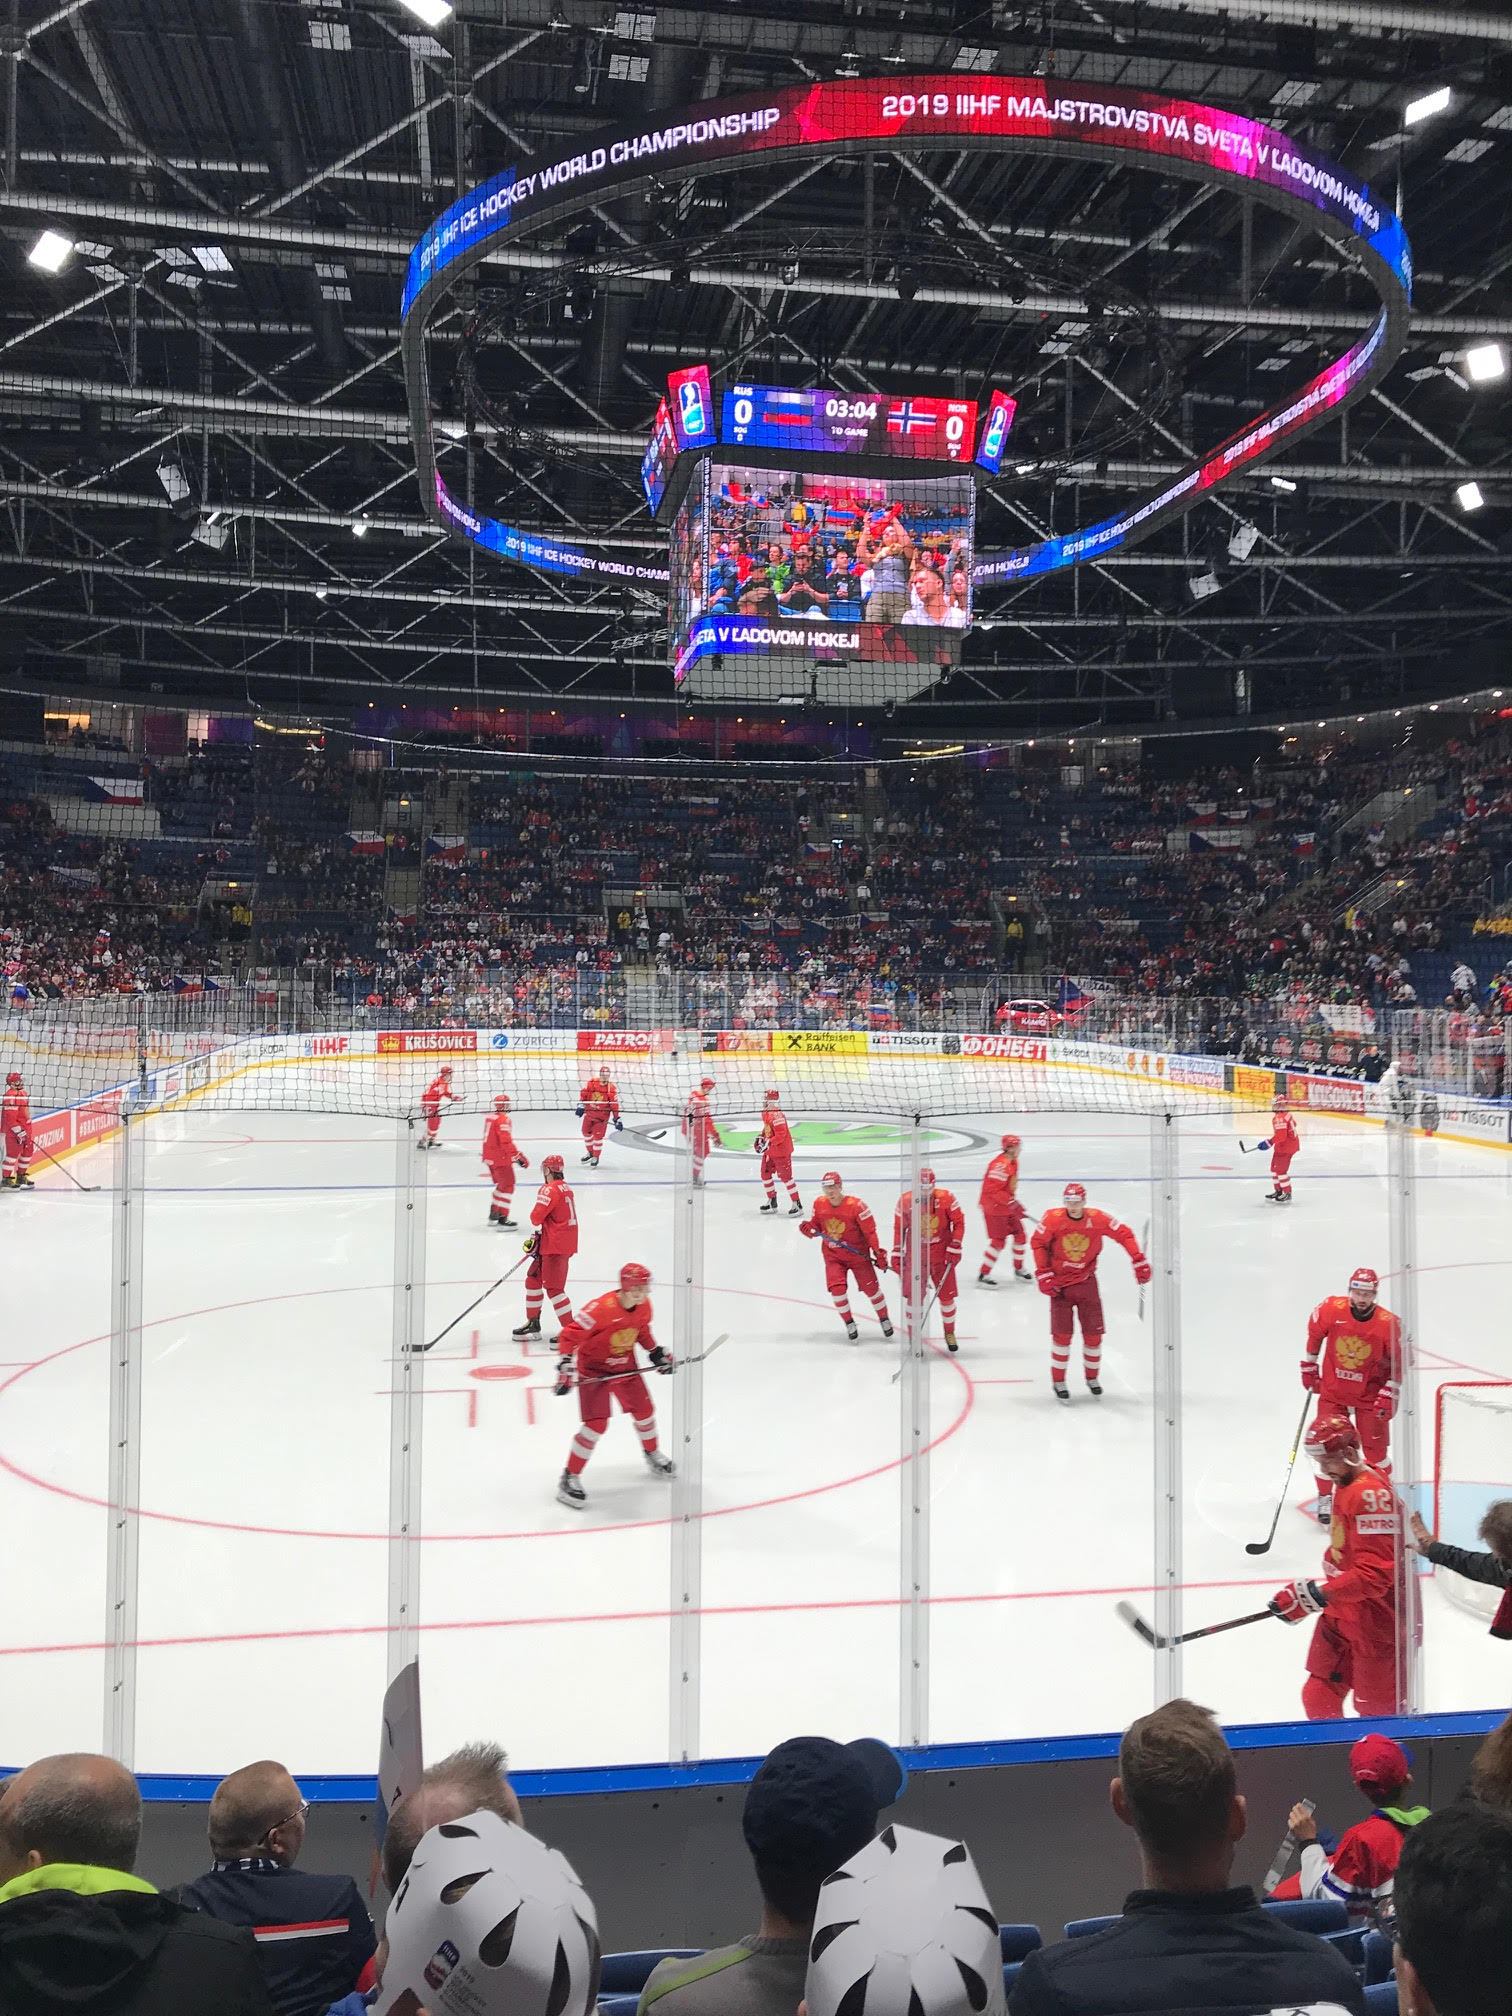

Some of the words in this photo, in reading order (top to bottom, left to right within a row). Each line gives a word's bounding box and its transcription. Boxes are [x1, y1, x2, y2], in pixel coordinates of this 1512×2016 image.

[882, 94, 949, 117] 2019
[956, 94, 1002, 116] IIHF
[1007, 96, 1190, 141] MAJSTROVSTVÁ
[1193, 123, 1254, 160] SVETA
[1256, 142, 1269, 164] V
[420, 236, 440, 272] 2019
[460, 207, 478, 233] ICE
[480, 174, 537, 220] HOCKEY
[540, 148, 606, 188] WORLD
[610, 107, 780, 164] CHAMPIONSHIP
[733, 386, 753, 396] RUS
[734, 399, 753, 424] 0
[825, 399, 877, 419] 03:04
[845, 427, 869, 437] GAME
[946, 415, 964, 440] 0
[505, 536, 526, 552] 2019
[544, 549, 559, 561] ICE
[559, 552, 596, 570] HOCKEY
[598, 561, 635, 576] WORLD
[1062, 540, 1085, 557] 2019
[719, 627, 730, 641] V
[731, 628, 805, 646] ĽADOVOM
[807, 631, 860, 649] HOKEJI
[313, 1037, 348, 1055] IIHF
[405, 1033, 475, 1050] KRUŠOVICE
[513, 1036, 558, 1046] ZURICH
[805, 1032, 855, 1043] Raiffeisen
[892, 1035, 938, 1046] TISSOT
[806, 1043, 836, 1052] BANK
[1460, 1109, 1505, 1128] TISSOT
[33, 1127, 64, 1153] BENZINA
[1361, 1489, 1393, 1512] 92
[1360, 1519, 1395, 1529] PATRO
